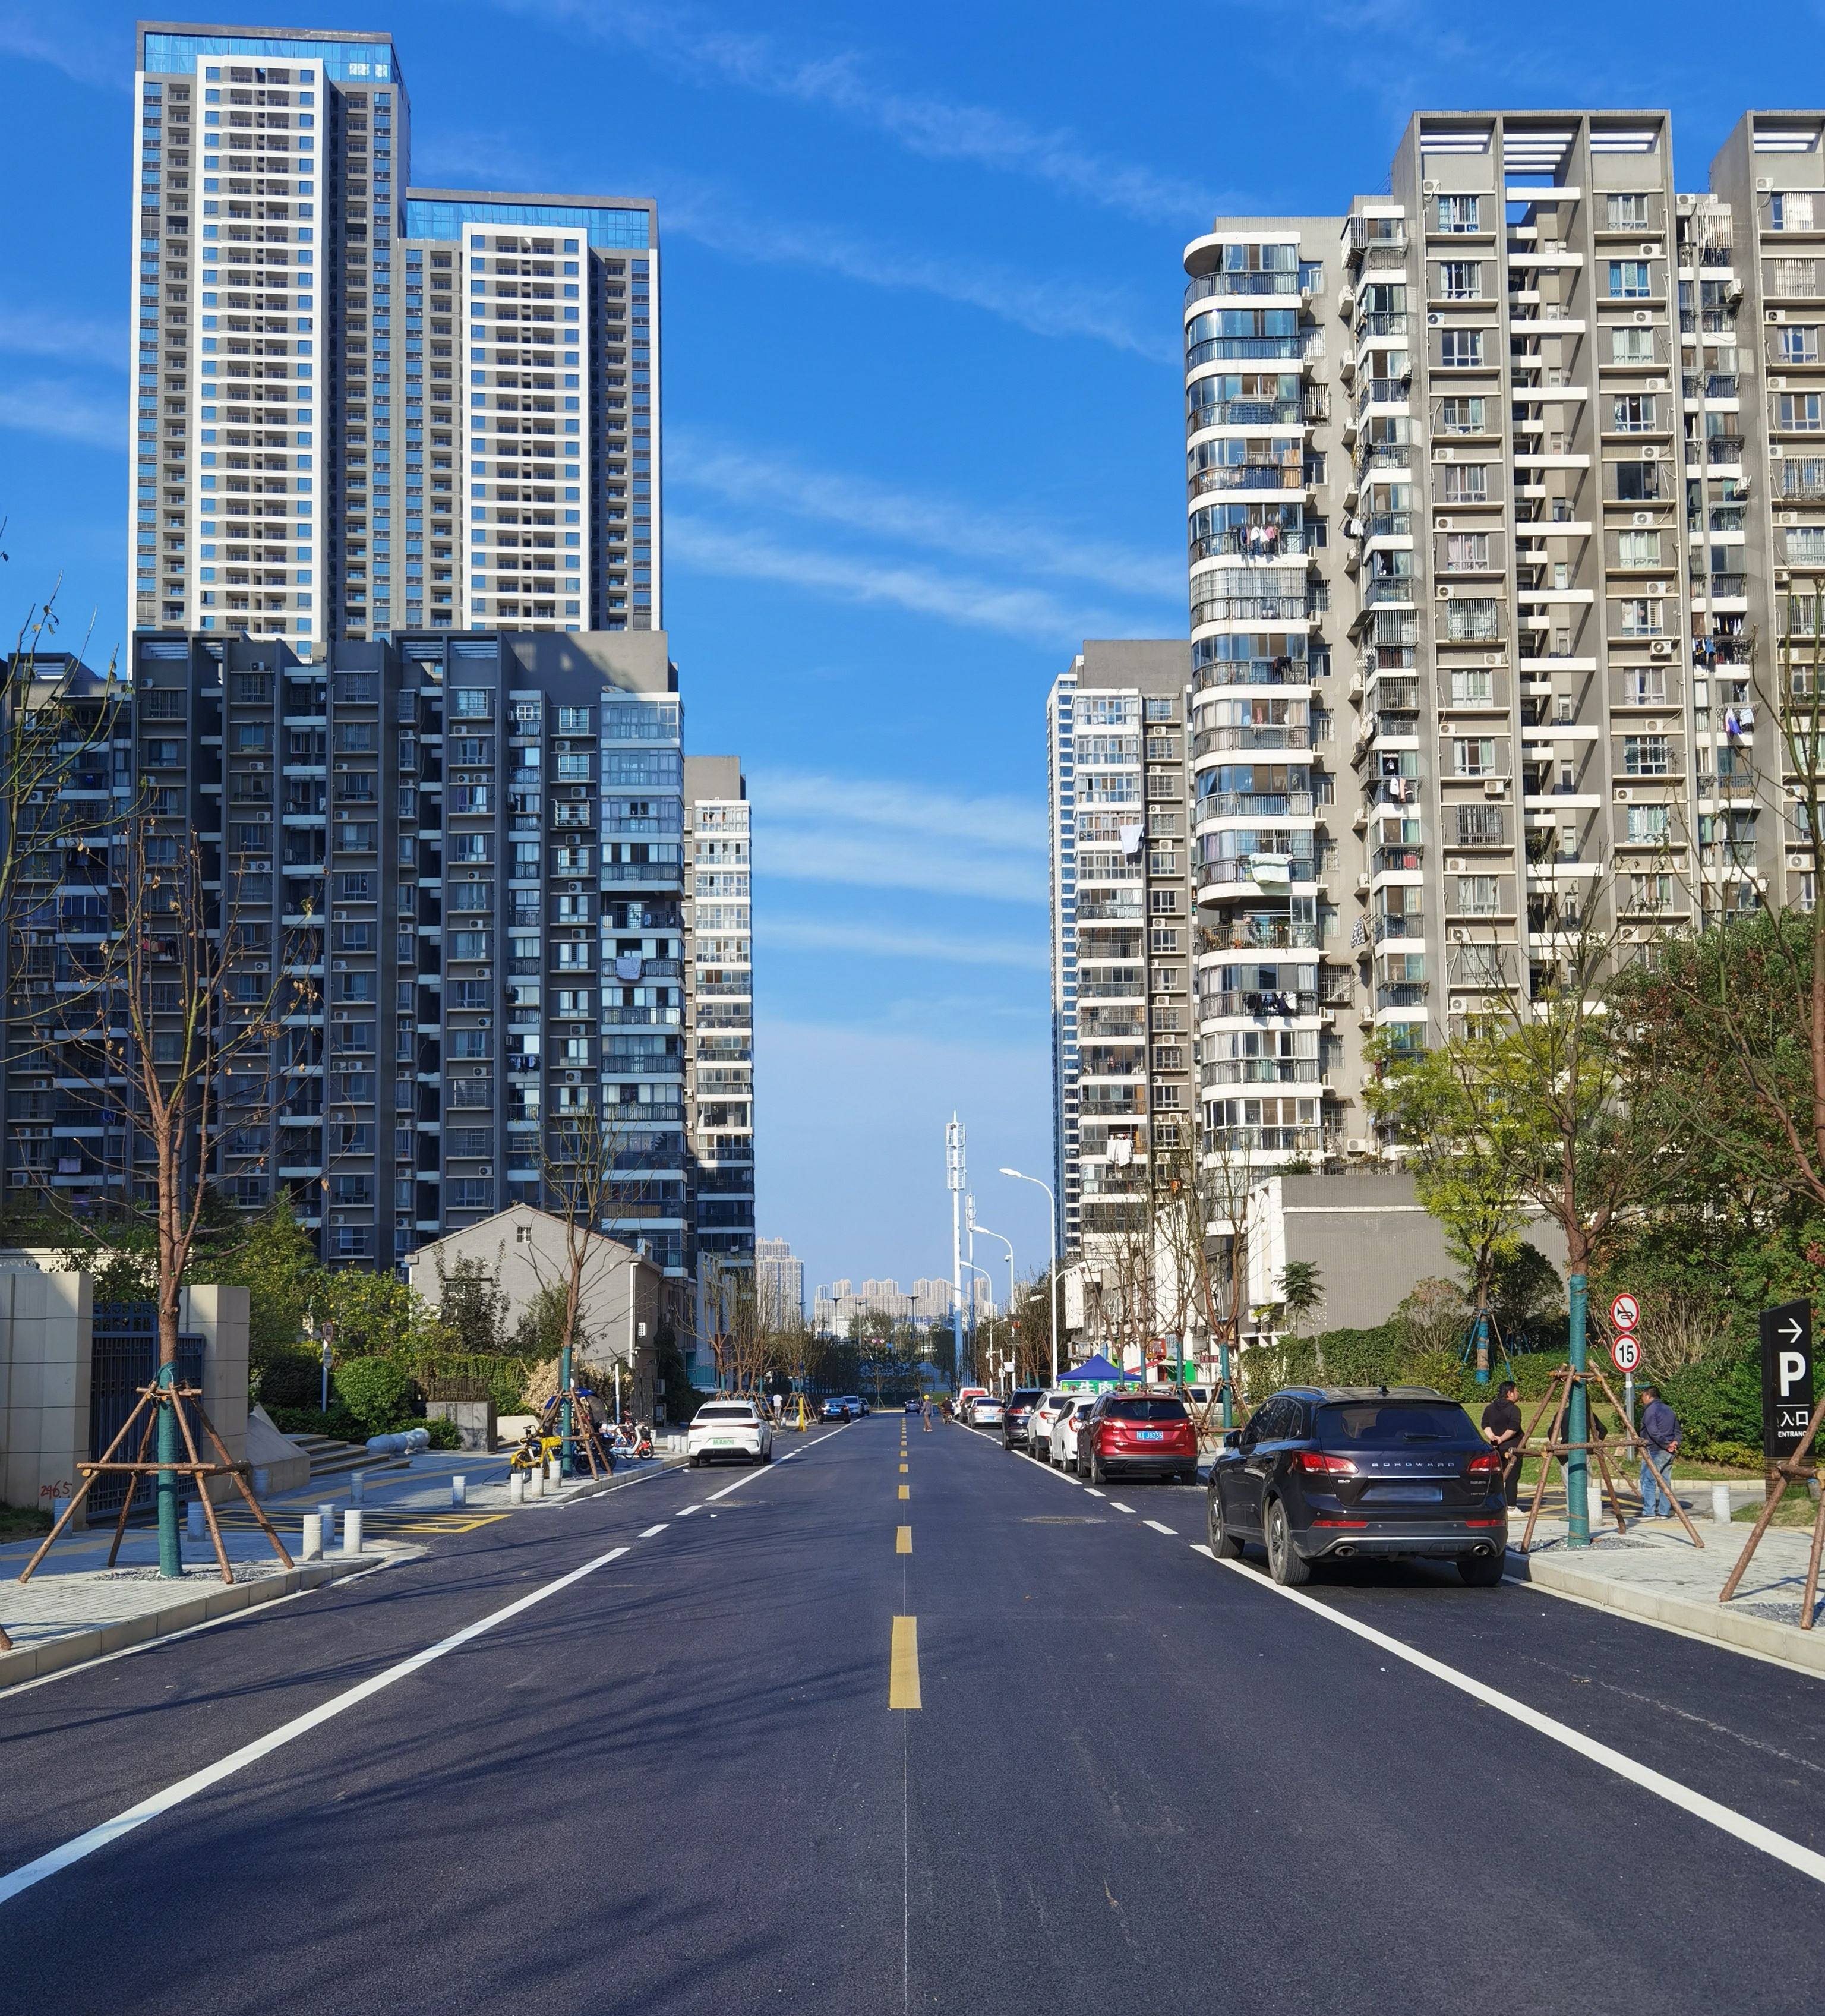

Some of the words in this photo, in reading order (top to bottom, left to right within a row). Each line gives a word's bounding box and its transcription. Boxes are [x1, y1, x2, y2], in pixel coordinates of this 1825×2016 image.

[1619, 1345, 1634, 1363] 15
[1779, 1352, 1806, 1396] P
[1780, 1411, 1808, 1427] 入口
